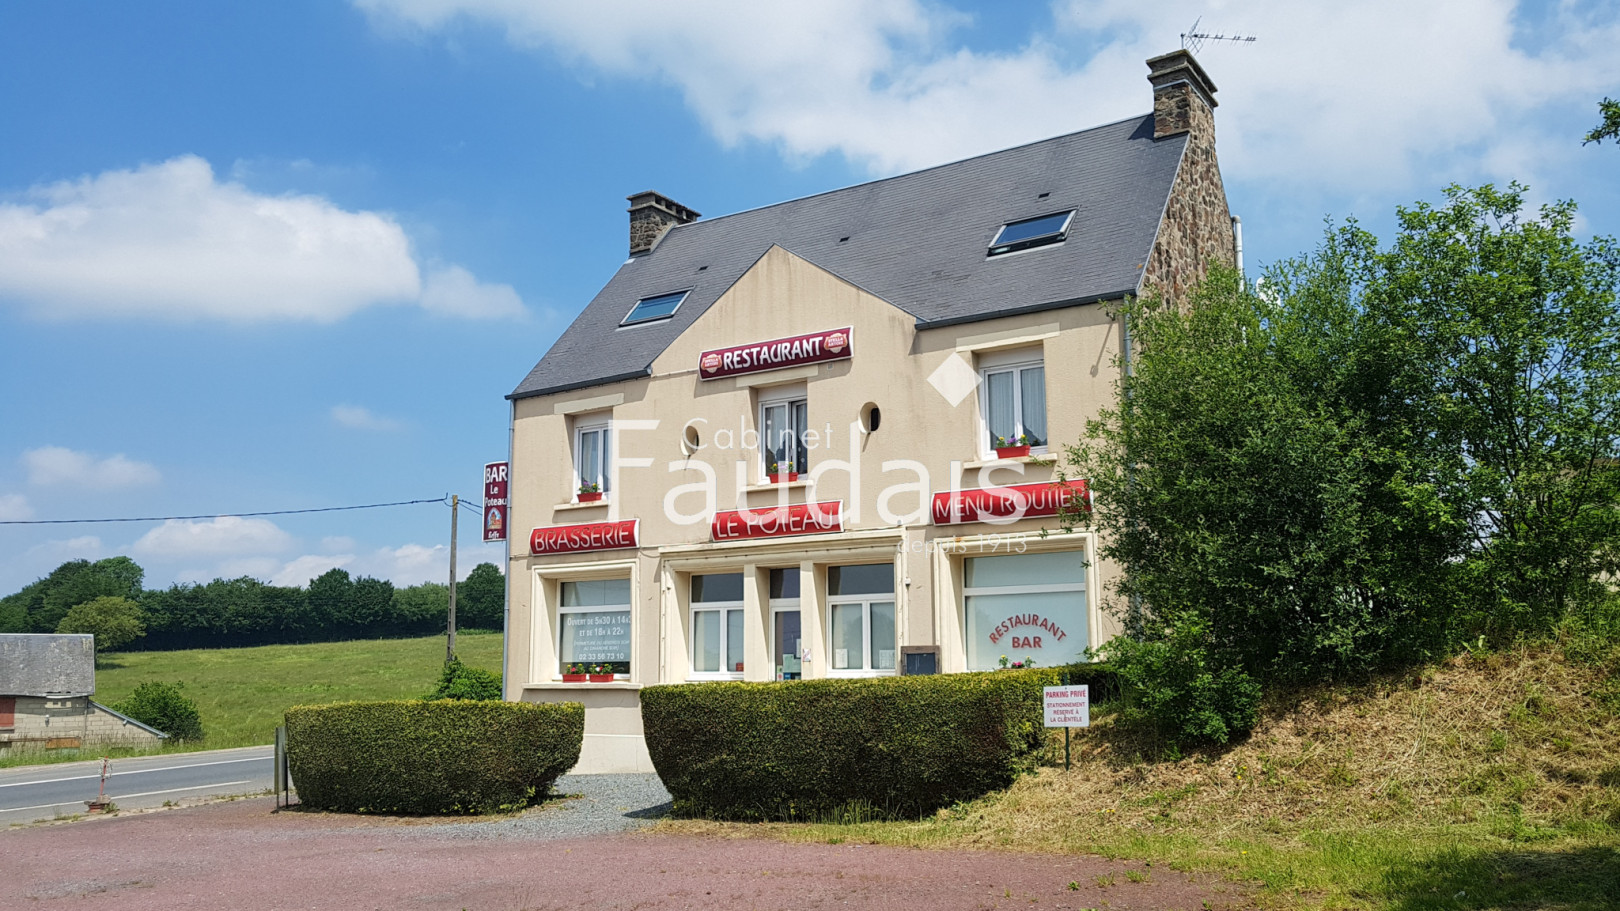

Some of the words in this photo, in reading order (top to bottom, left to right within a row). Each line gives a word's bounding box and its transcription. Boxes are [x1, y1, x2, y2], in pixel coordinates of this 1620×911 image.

[723, 336, 824, 371] RESTAURANT
[486, 465, 508, 484] BAR
[490, 484, 499, 495] Le
[485, 497, 507, 508] Poteau
[935, 493, 994, 519] MENU
[716, 511, 739, 538] LE
[747, 502, 834, 535] POTEAU
[534, 522, 631, 551] BRASSERIE
[989, 613, 1067, 644] RESTAURANT
[1012, 636, 1042, 648] BAR
[1070, 689, 1086, 697] PRIVÉ
